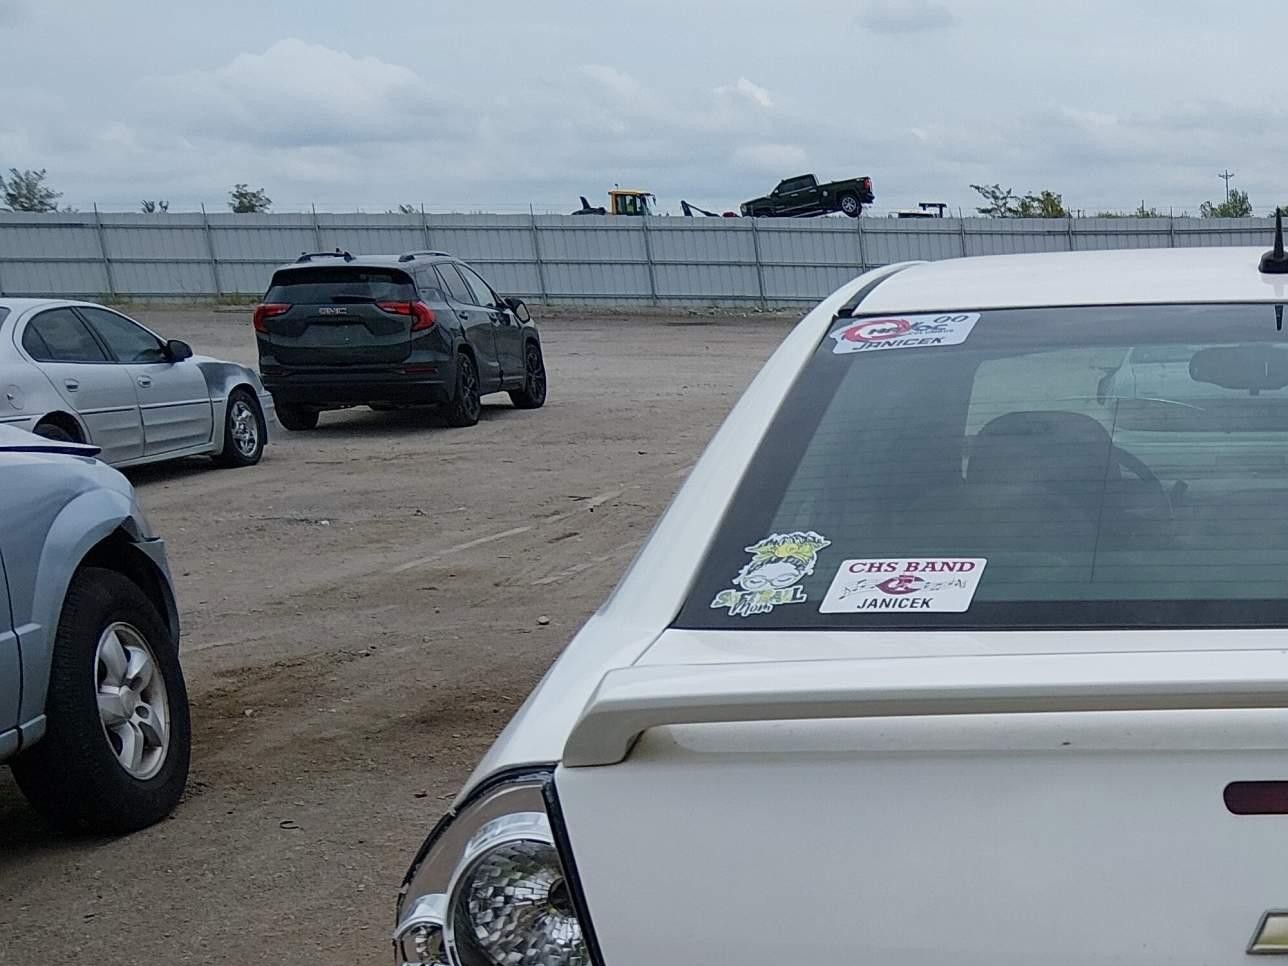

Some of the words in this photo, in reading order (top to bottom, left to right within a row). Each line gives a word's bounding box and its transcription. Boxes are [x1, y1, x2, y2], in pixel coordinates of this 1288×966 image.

[853, 337, 944, 350] JANICEK
[848, 561, 899, 573] CHS
[904, 561, 976, 573] BAND
[856, 597, 934, 610] JANICEK
